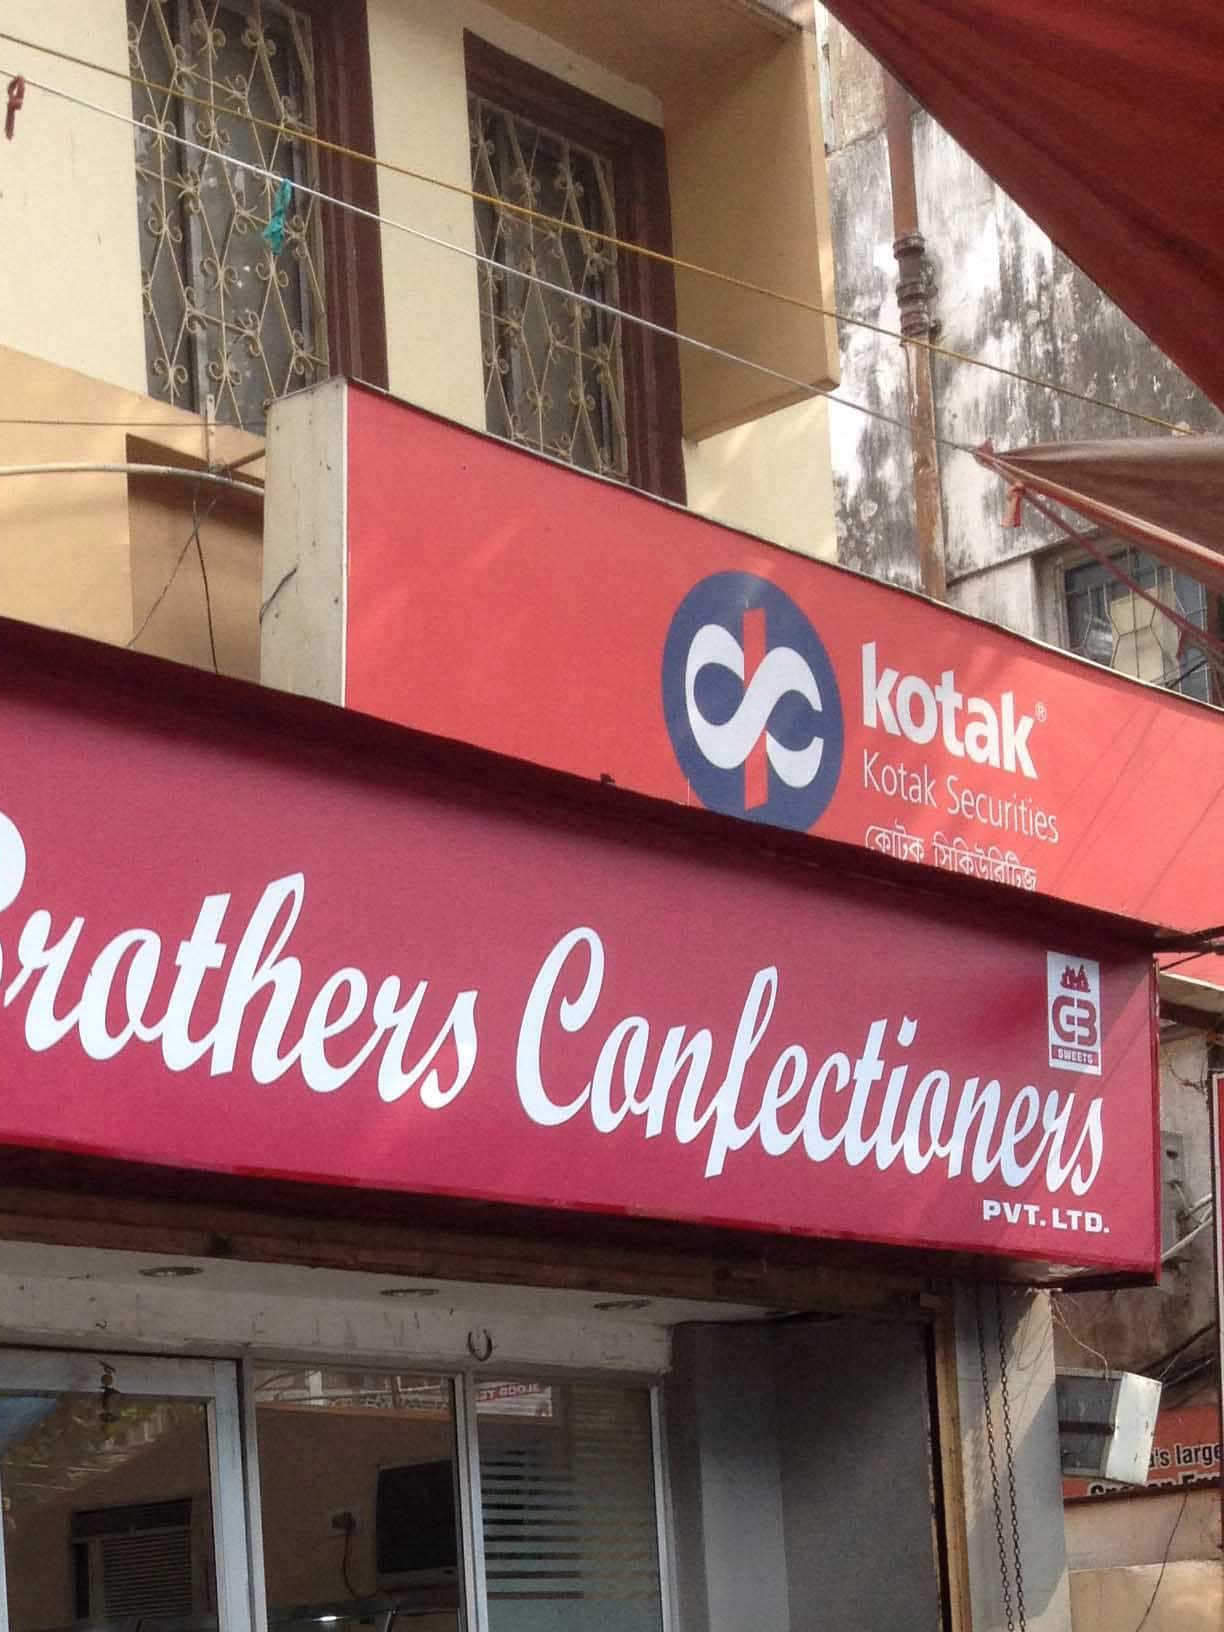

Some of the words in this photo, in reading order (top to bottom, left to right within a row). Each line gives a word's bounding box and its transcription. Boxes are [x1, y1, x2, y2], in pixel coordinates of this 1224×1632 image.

[861, 641, 1039, 780] kotak
[863, 749, 937, 809] Kotak
[946, 774, 1060, 844] Securities
[515, 926, 1105, 1197] Confectioners
[1057, 1047, 1094, 1065] SWEETS
[983, 1199, 1046, 1227] PVT.
[1052, 1207, 1111, 1234] LTD.
